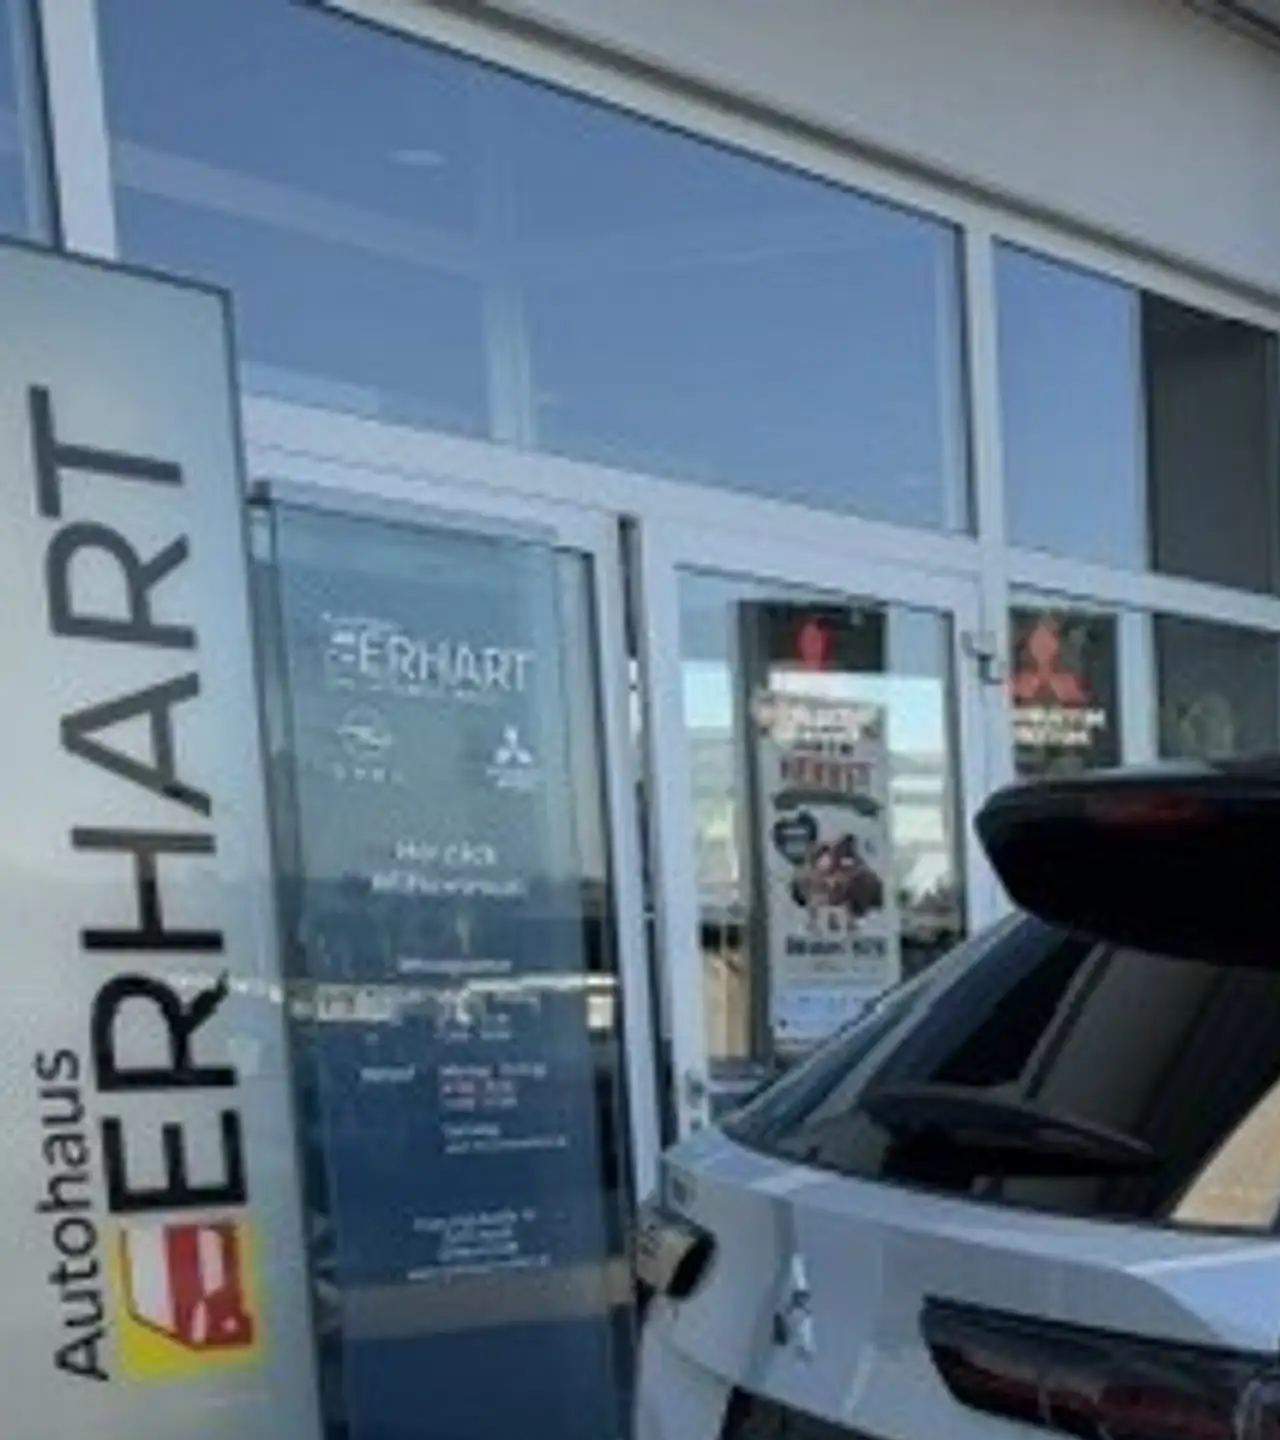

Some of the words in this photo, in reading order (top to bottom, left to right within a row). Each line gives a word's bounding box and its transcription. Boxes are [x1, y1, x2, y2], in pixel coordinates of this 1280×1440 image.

[28, 385, 249, 1213] ERHART
[358, 630, 534, 692] ERHART
[36, 1048, 109, 1382] Autohaus
